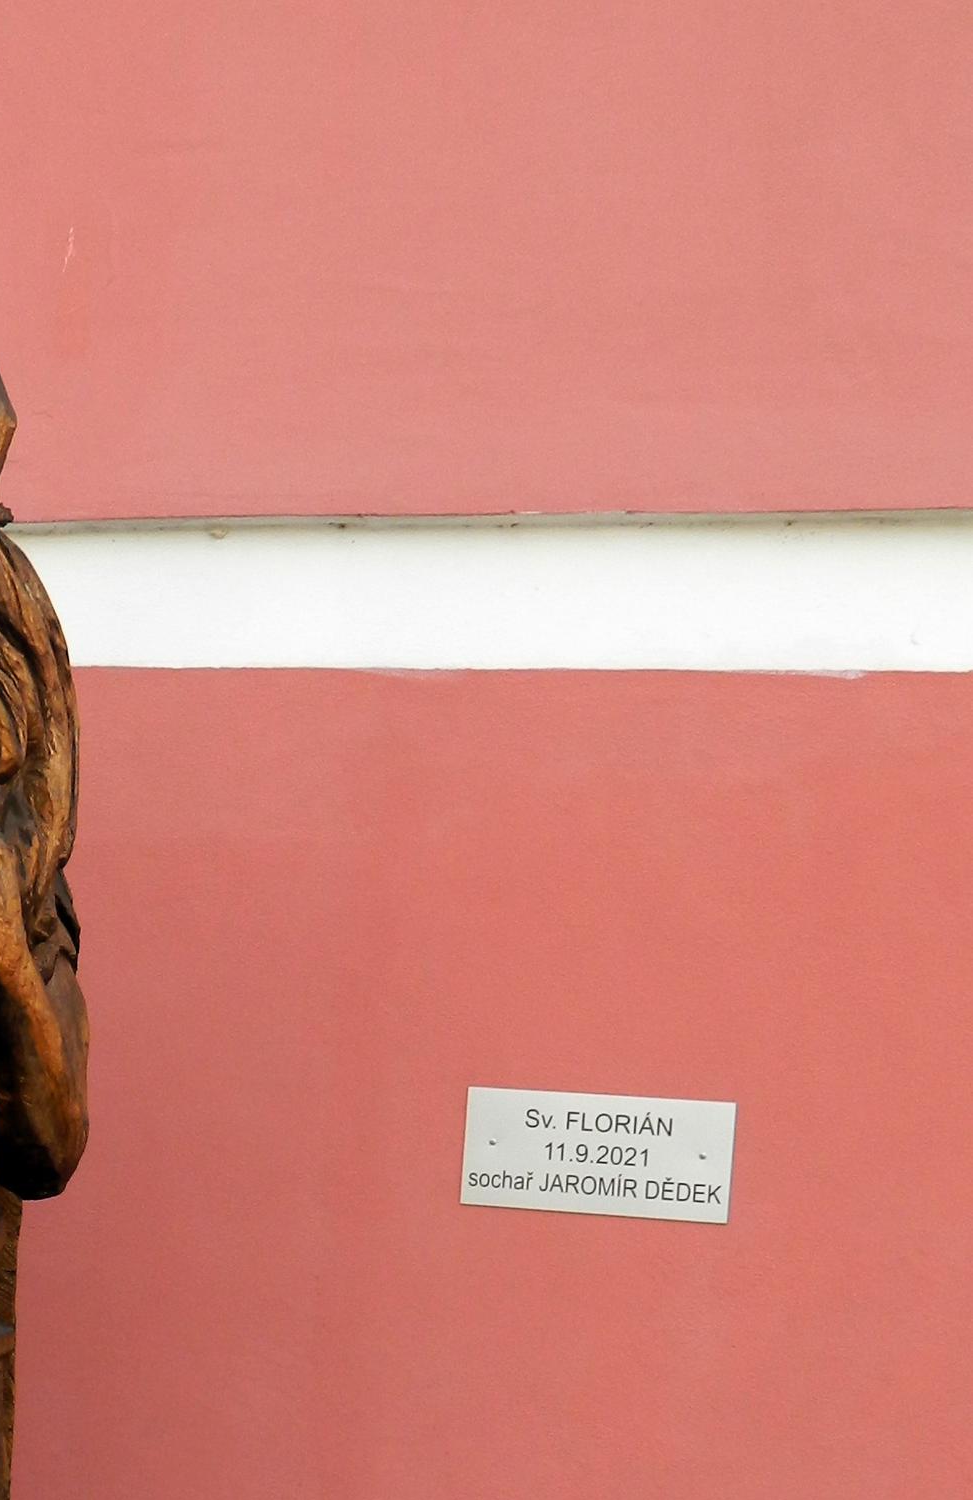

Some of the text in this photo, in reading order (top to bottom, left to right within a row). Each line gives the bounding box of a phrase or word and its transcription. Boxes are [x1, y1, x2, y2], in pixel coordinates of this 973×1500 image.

[525, 1108, 674, 1137] Sv. FLORIÁN
[545, 1142, 649, 1167] 11.9.2021
[468, 1170, 722, 1204] sochař JAROMÍR DĚDEK
